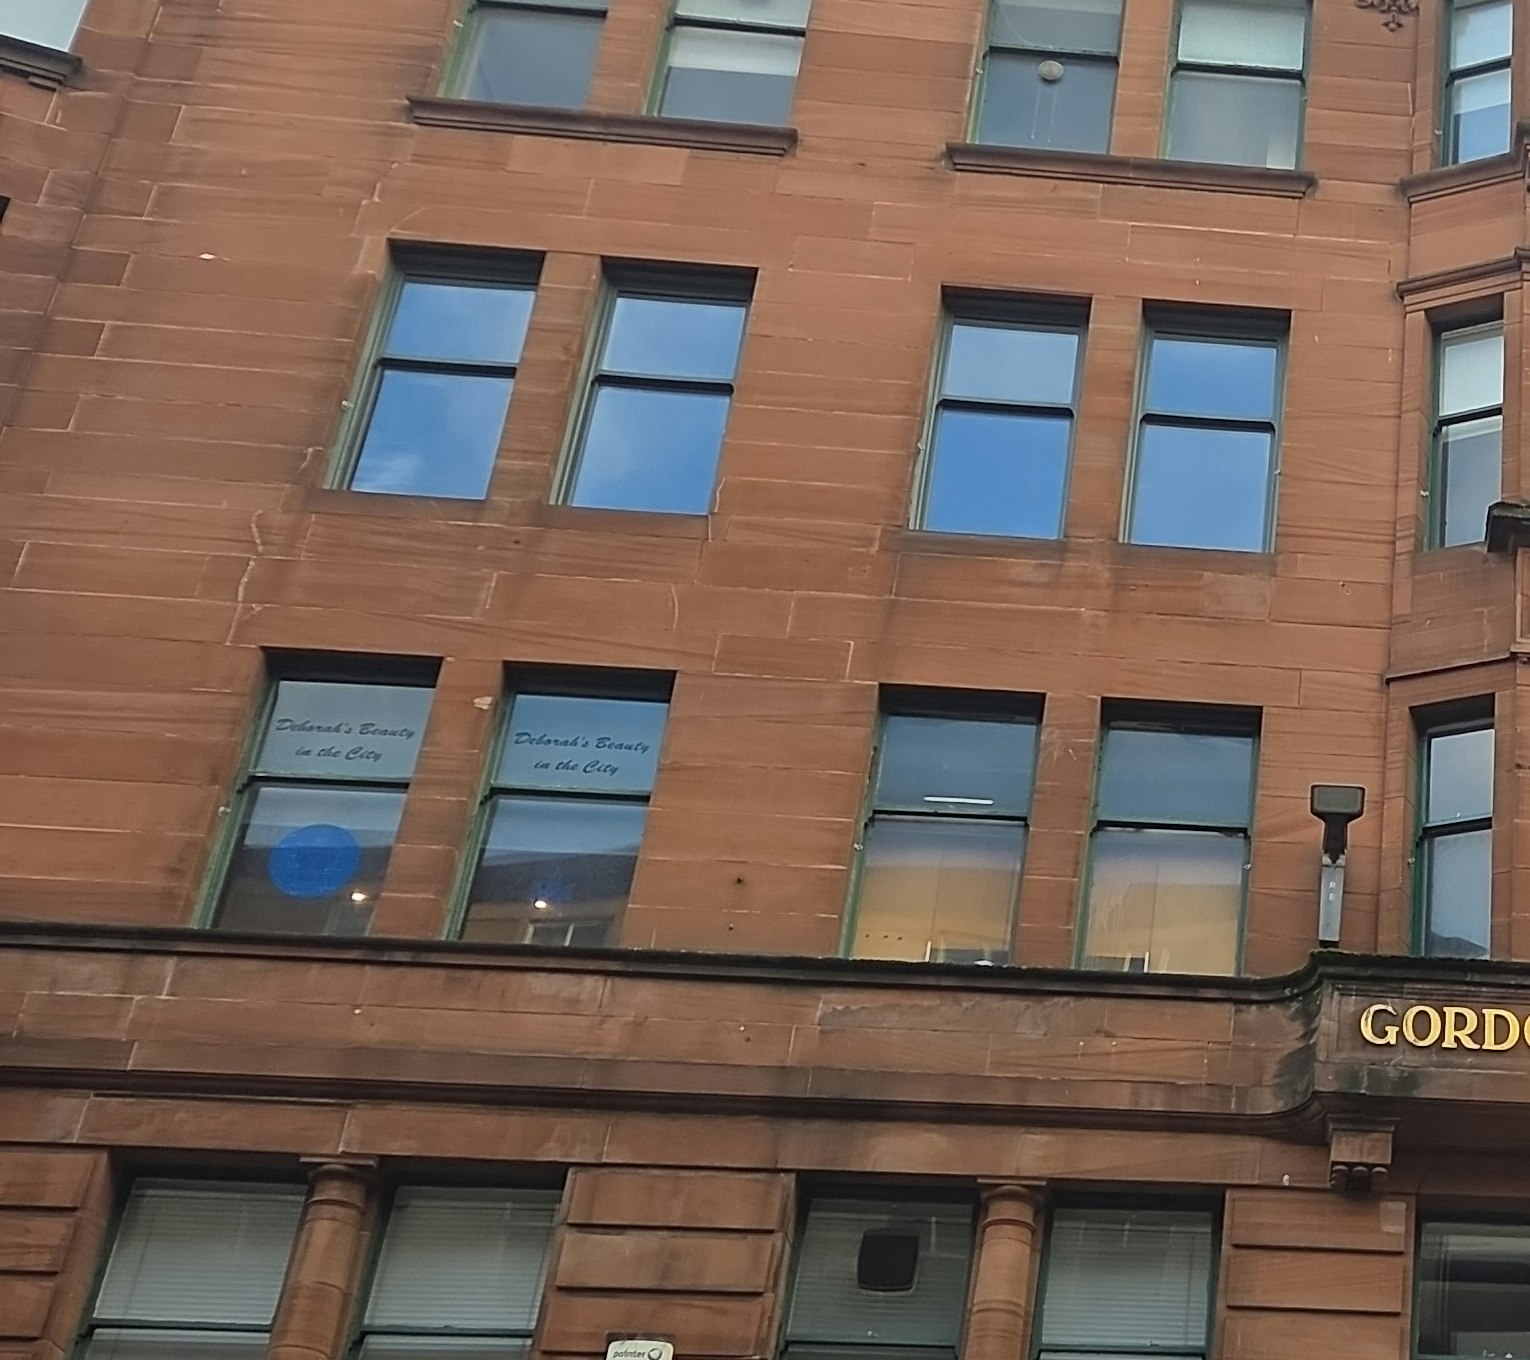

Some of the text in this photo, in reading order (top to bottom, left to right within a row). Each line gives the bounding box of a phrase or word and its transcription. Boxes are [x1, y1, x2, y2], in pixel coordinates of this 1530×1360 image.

[275, 718, 416, 740] Deborah's Beauty
[514, 732, 650, 755] Deborah's Beauty
[295, 746, 383, 762] in the City
[534, 759, 621, 776] in the City
